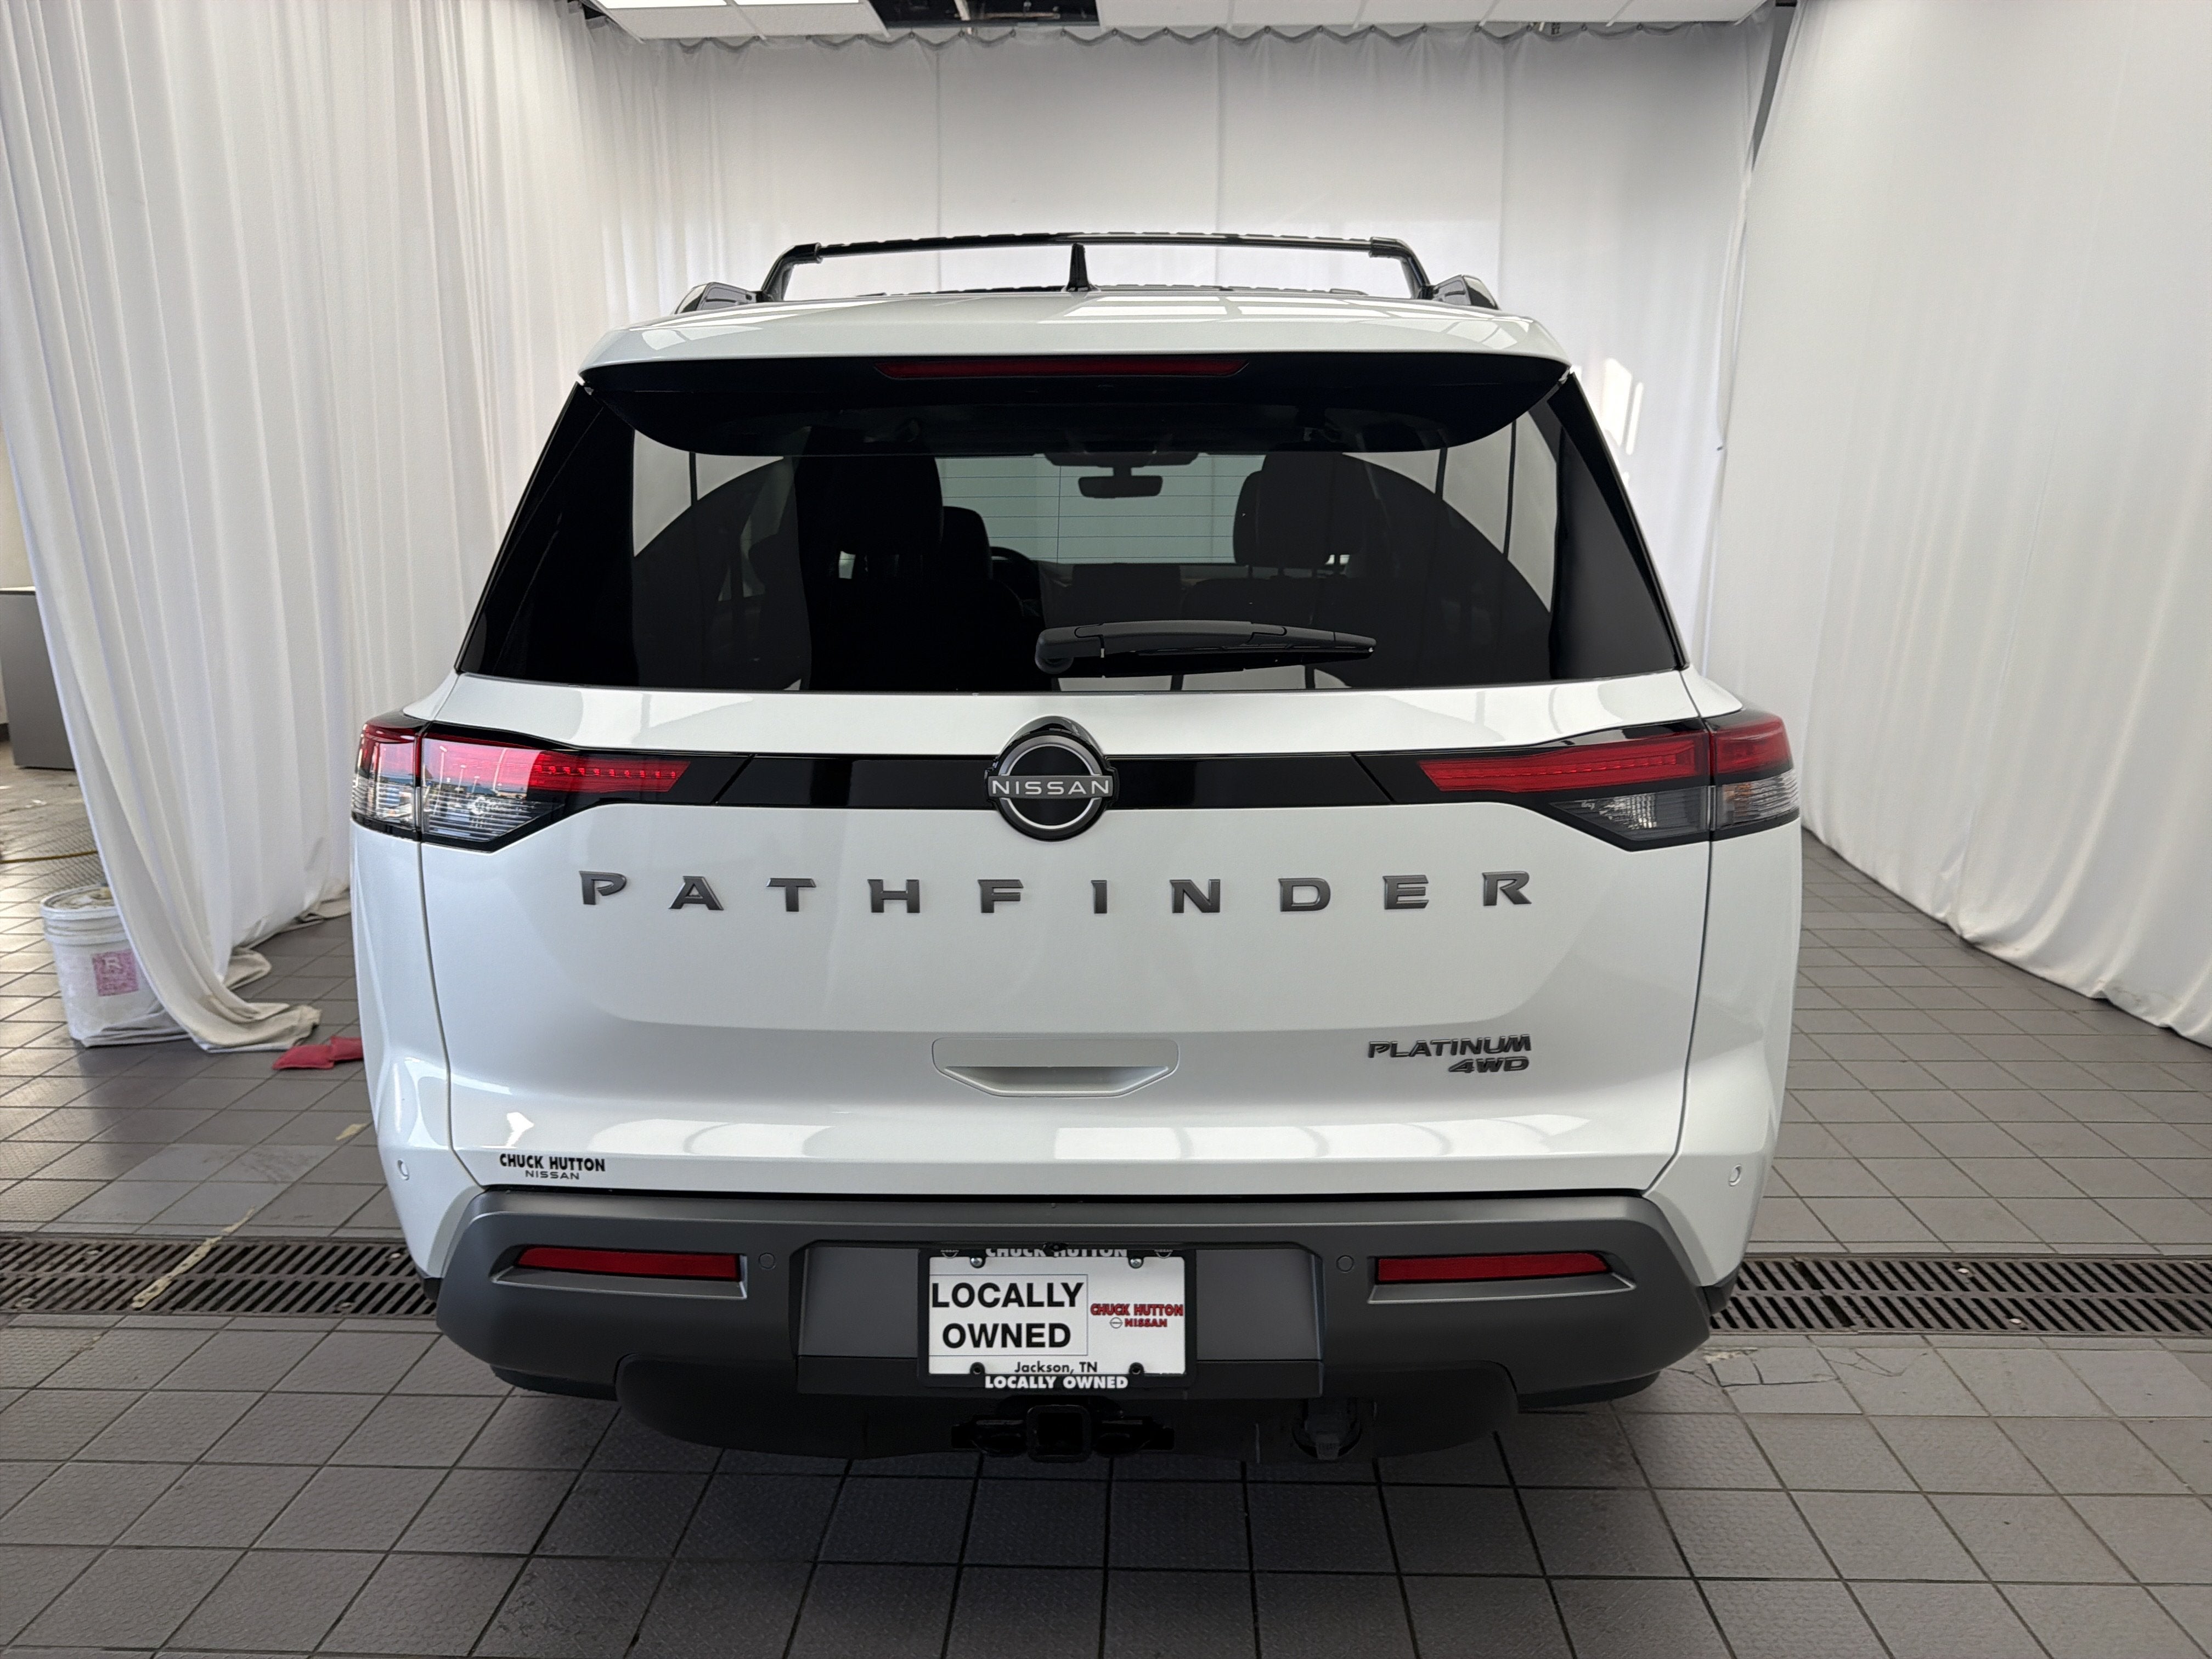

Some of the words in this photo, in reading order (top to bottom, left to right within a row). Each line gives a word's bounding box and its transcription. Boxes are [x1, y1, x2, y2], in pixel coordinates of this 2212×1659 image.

[992, 780, 1109, 795] NISSAN
[579, 871, 1532, 914] PATHFINDER
[1368, 1034, 1531, 1058] PLATINUM
[1448, 1056, 1530, 1073] 4WD
[500, 1153, 544, 1169] CHUCK
[549, 1156, 606, 1171] HUTTON
[526, 1170, 579, 1180] NISSAN
[932, 1282, 1084, 1308] LOCALLY
[1090, 1303, 1130, 1316] CHUCK
[1133, 1304, 1183, 1316] HUTTON
[1125, 1318, 1167, 1327] NISSAN
[943, 1323, 1071, 1348] OWNED
[1014, 1361, 1074, 1375] Jackson,
[1079, 1362, 1098, 1372] TN
[985, 1376, 1057, 1389] LOCALLY
[1063, 1376, 1128, 1389] OWNED
